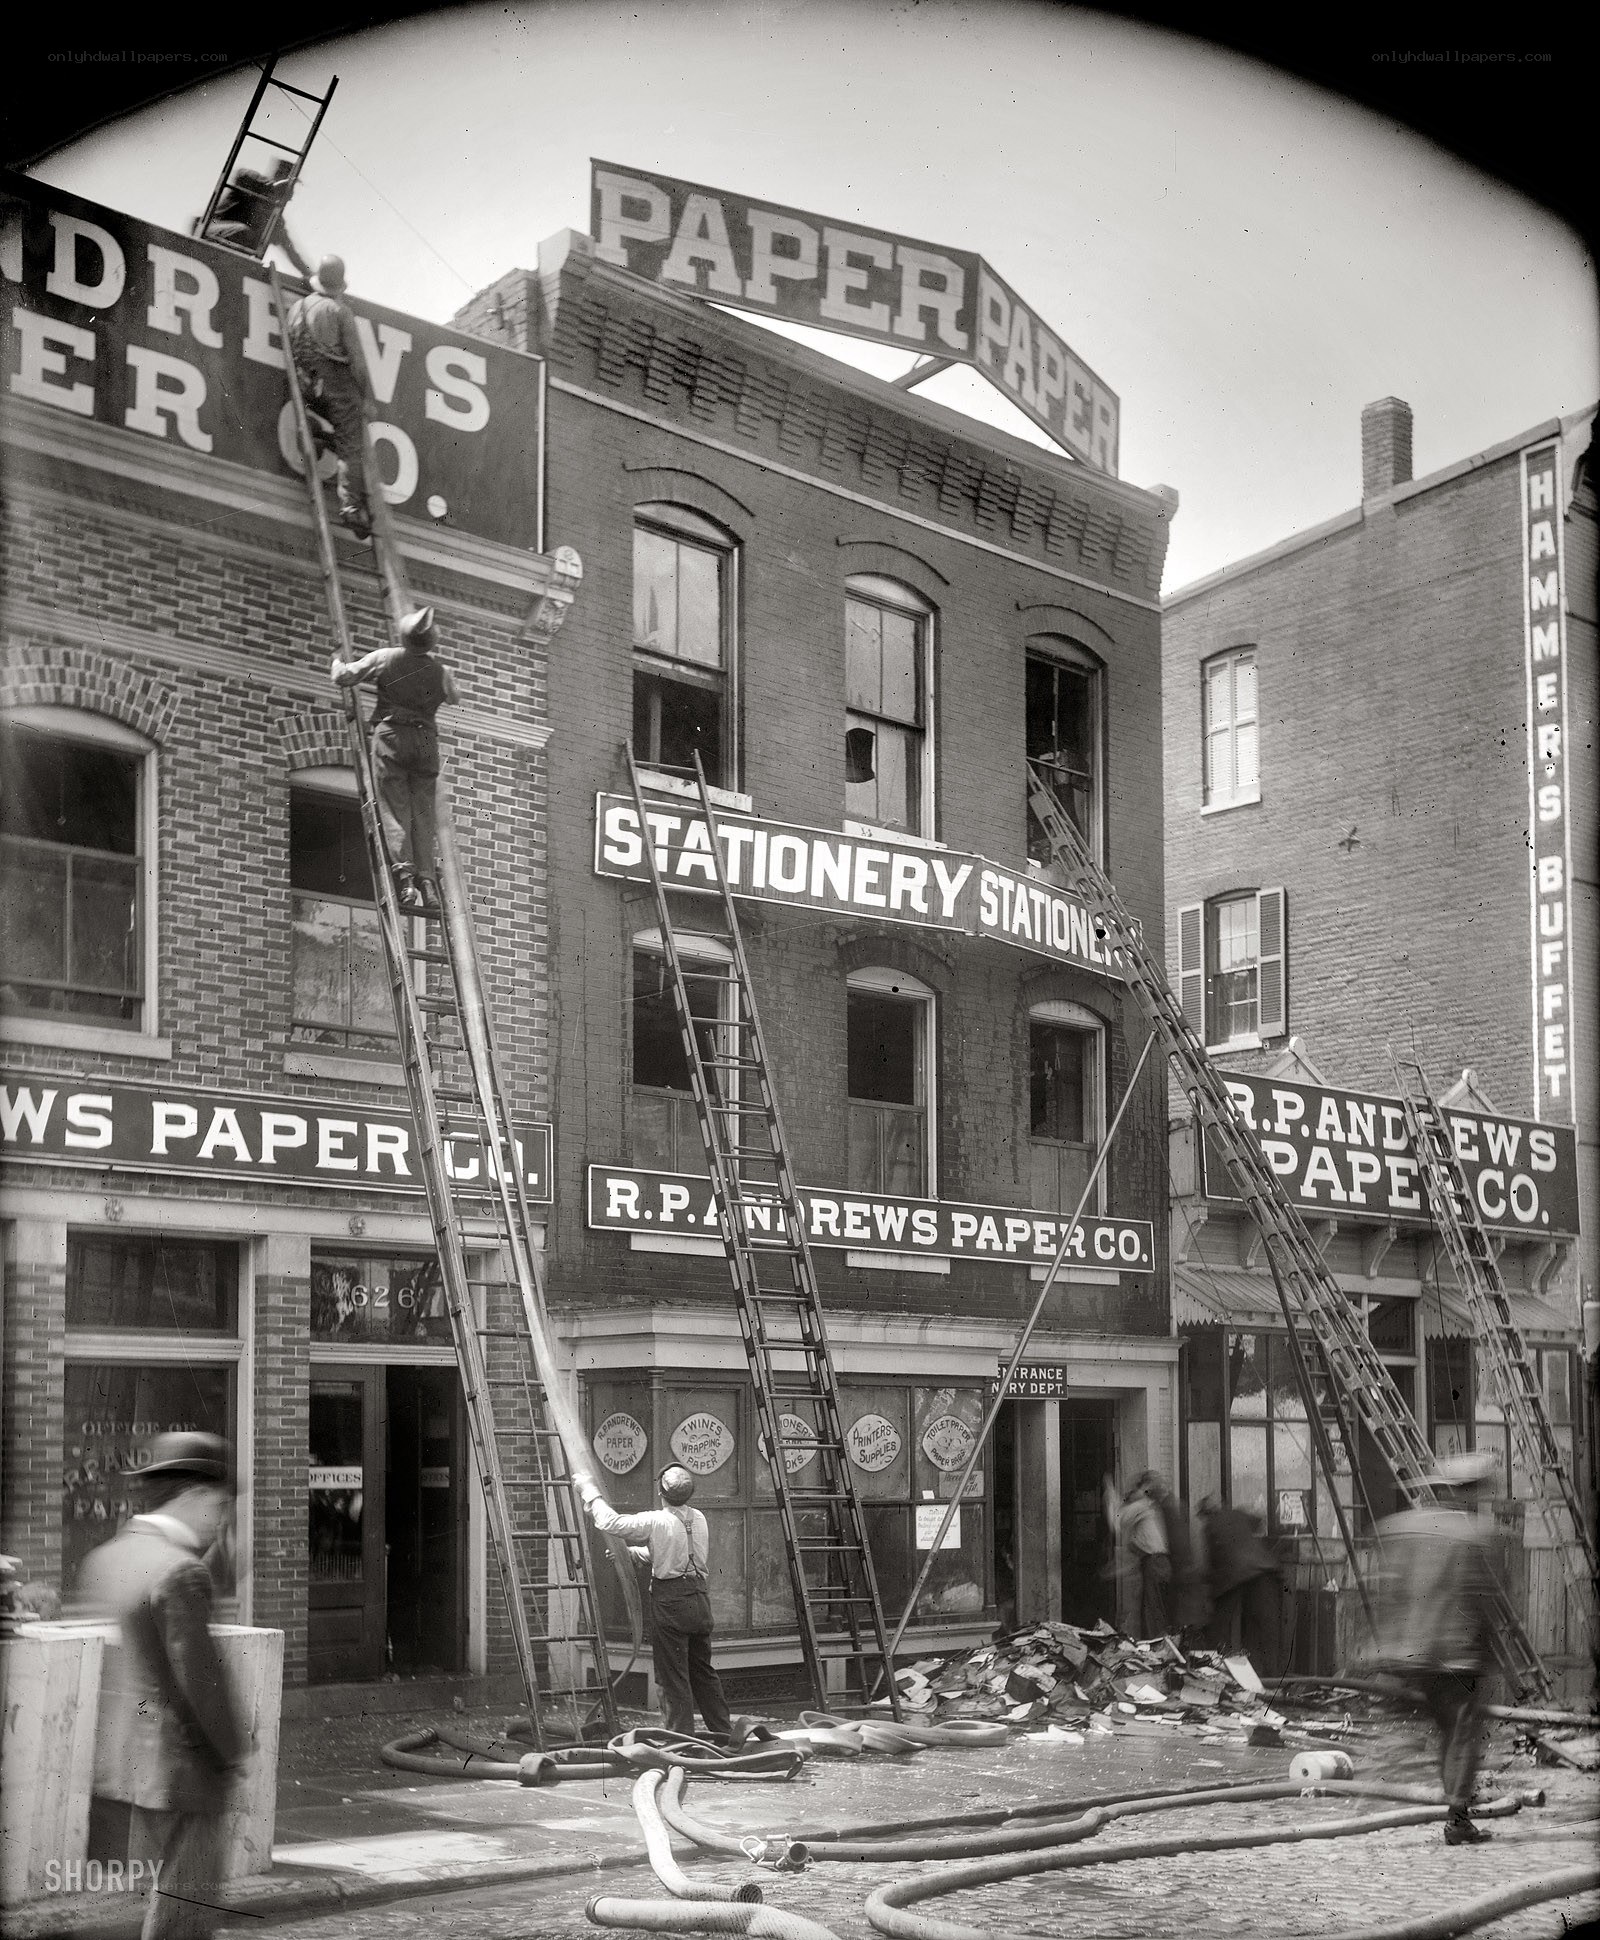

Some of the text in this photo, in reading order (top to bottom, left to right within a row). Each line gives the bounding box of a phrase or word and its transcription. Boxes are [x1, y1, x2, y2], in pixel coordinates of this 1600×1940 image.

[594, 169, 969, 351] PAPER
[0, 202, 491, 432] DREWS
[977, 265, 1118, 479] PAPER
[603, 806, 974, 919] STATIONERY
[1538, 855, 1567, 1098] BUFFET
[149, 1100, 413, 1177] PAPER
[443, 1130, 539, 1186] CO.
[1476, 1167, 1550, 1225] CO.
[951, 1211, 1087, 1258] PAPER
[1093, 1226, 1149, 1264] CO.
[351, 1284, 415, 1310] 626
[1030, 1383, 1064, 1395] DEPT.
[680, 1418, 723, 1436] TWINES
[853, 1424, 893, 1447] PRINTERS
[926, 1419, 972, 1443] TOILET PAPER
[606, 1437, 634, 1449] PAPER
[680, 1438, 722, 1454] WRAPPING
[859, 1441, 897, 1464] SUPPLIES
[603, 1449, 638, 1471] COMPANY
[930, 1447, 950, 1467] PAPER
